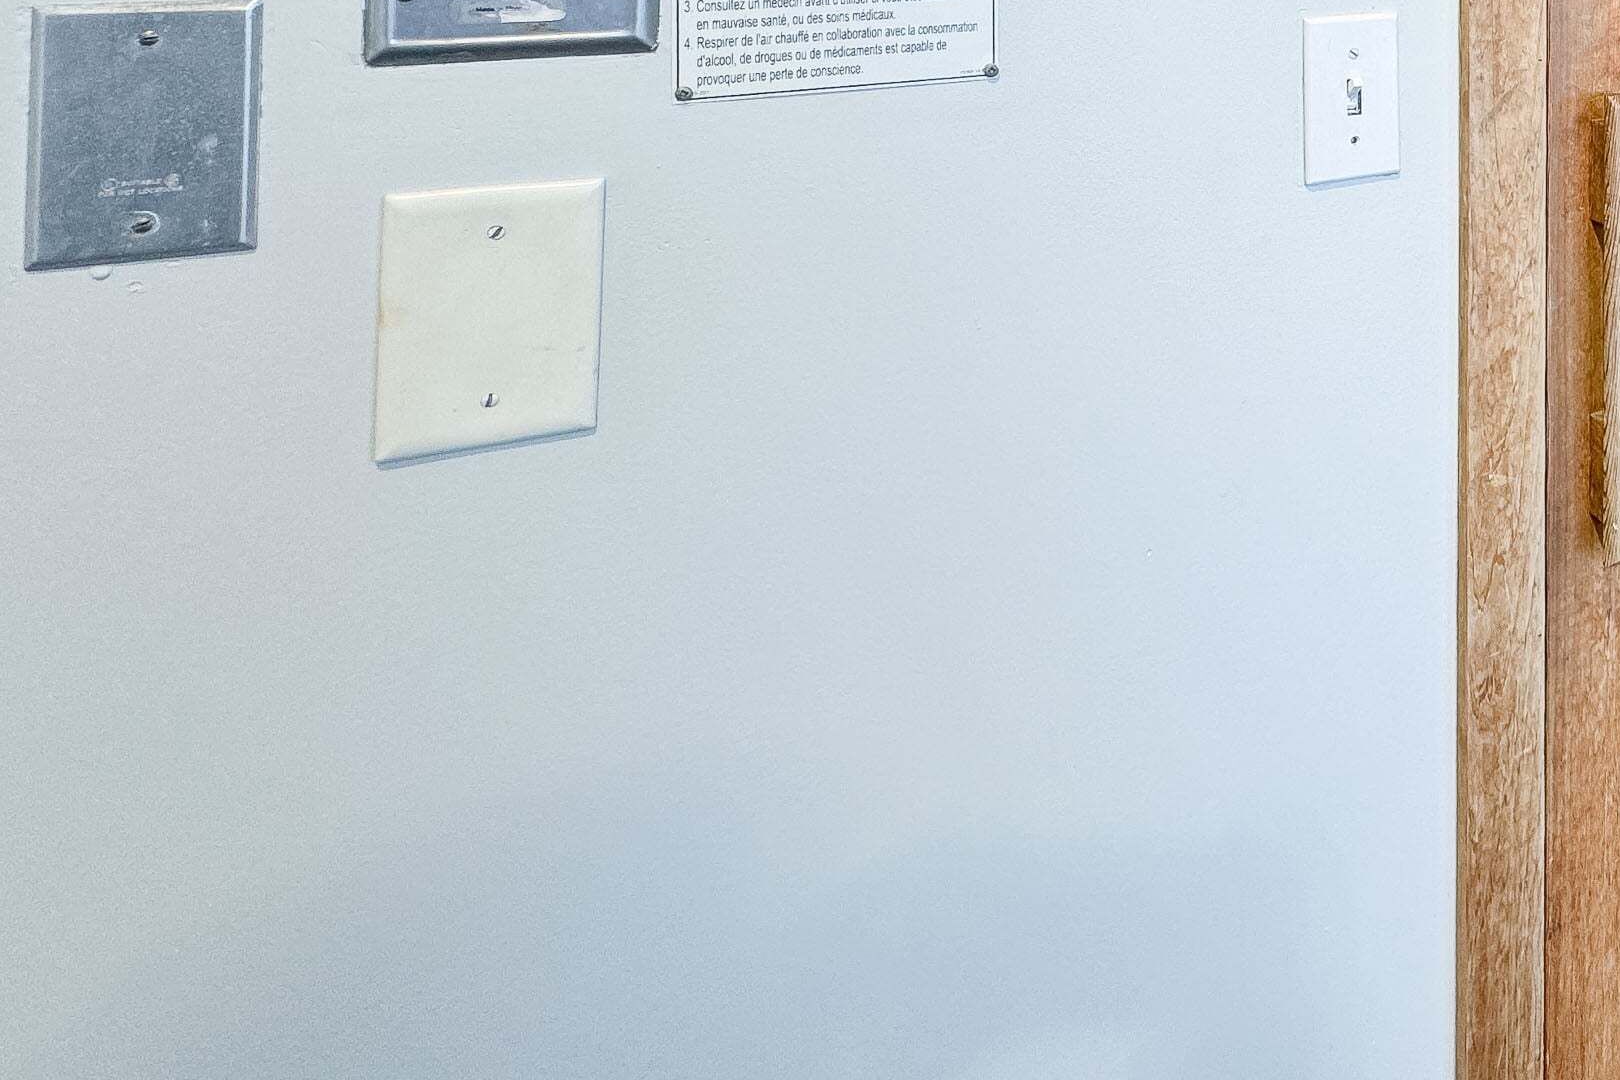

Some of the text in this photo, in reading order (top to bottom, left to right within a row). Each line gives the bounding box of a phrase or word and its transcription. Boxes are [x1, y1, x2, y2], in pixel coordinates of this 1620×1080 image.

[748, 0, 759, 9] un
[696, 20, 708, 29] en
[712, 16, 758, 29] mauvaise
[792, 16, 804, 24] ou
[806, 12, 823, 24] des
[696, 35, 737, 52] Respirer
[740, 34, 754, 45] de
[812, 32, 823, 41] en
[885, 27, 906, 37] avec
[908, 24, 915, 35] la
[917, 21, 977, 35] consommation
[740, 52, 751, 63] de
[754, 49, 792, 66] drogues
[795, 51, 806, 60] ou
[809, 48, 821, 59] de
[885, 44, 897, 54] est
[901, 41, 933, 56] capable
[936, 40, 946, 50] de
[696, 73, 745, 89] provoquer
[749, 71, 766, 81] une
[769, 68, 793, 83] perte
[796, 66, 808, 78] de
